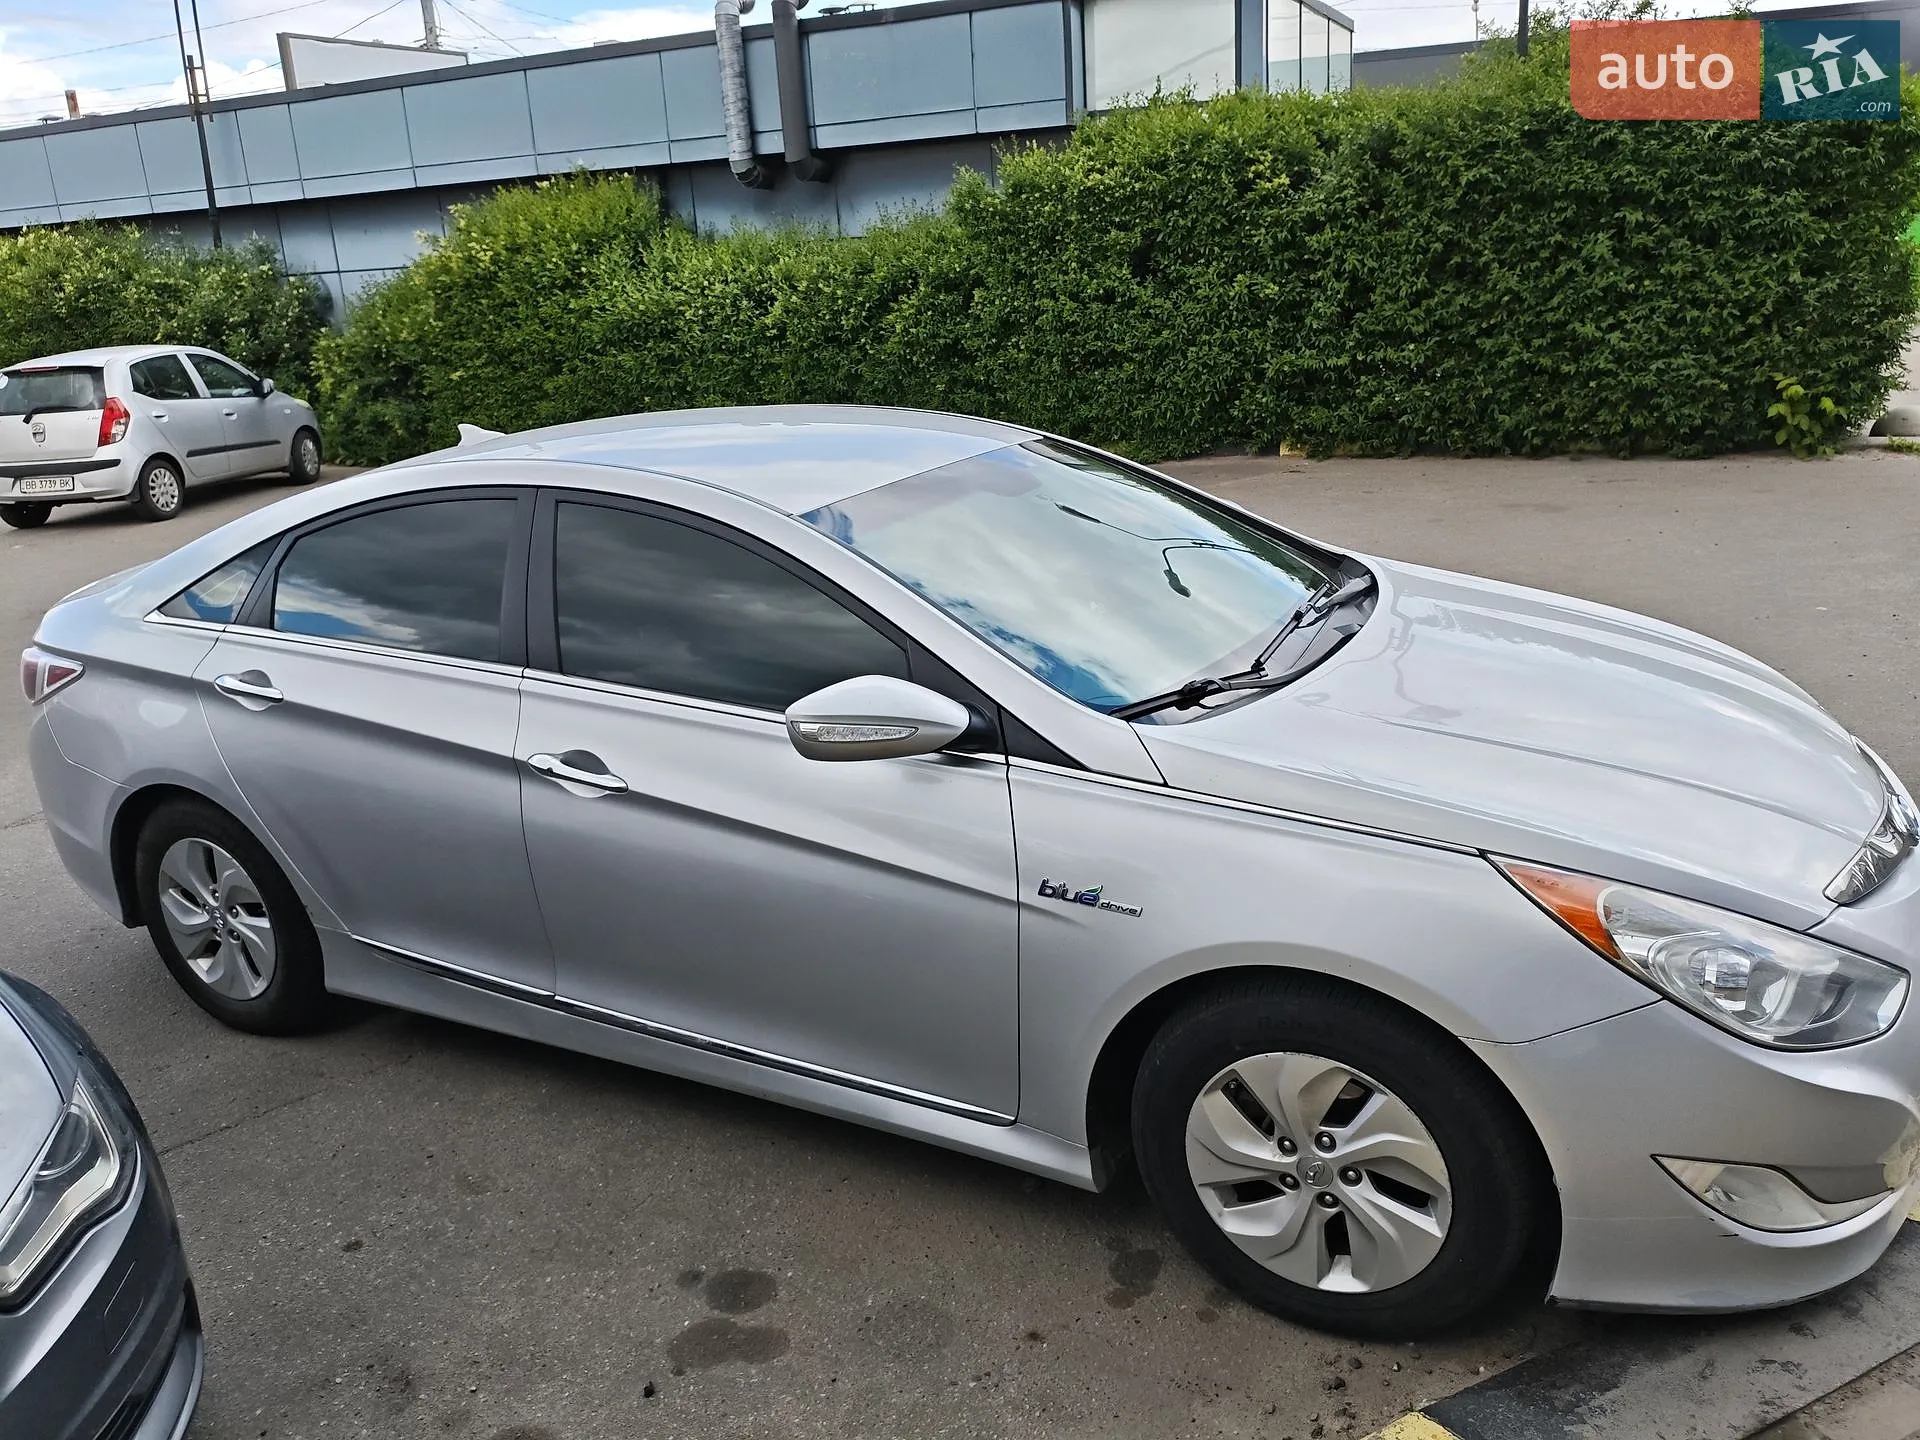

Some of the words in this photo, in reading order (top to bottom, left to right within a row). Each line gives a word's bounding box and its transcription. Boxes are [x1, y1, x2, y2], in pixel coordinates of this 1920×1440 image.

[25, 481, 37, 489] BB
[39, 480, 57, 489] 3739
[59, 479, 71, 488] BK
[1037, 878, 1100, 907] blue
[1100, 901, 1138, 915] drive
